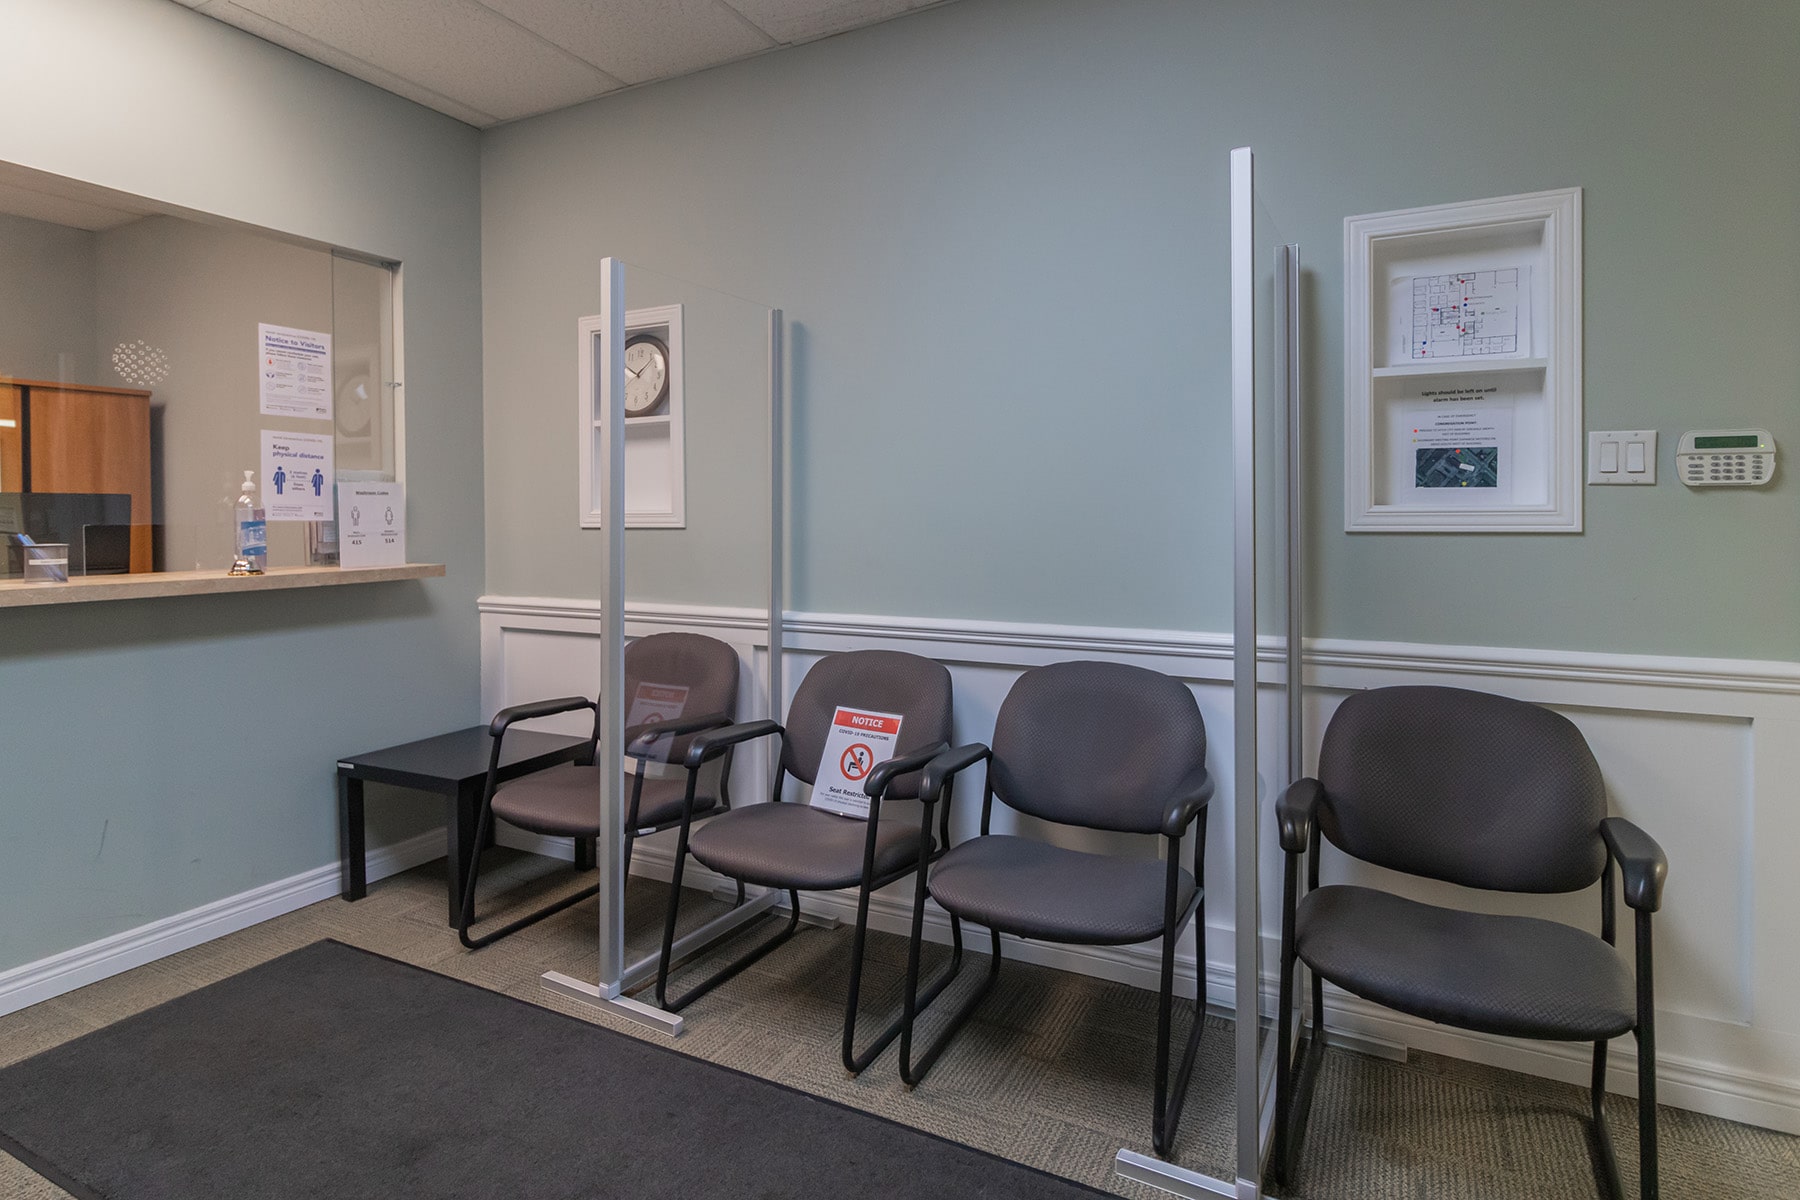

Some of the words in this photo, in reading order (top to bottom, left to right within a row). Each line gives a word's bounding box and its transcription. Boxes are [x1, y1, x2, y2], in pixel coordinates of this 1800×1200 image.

[265, 335, 288, 344] Notice
[300, 340, 324, 350] Visitors
[638, 348, 644, 358] 12
[644, 392, 648, 400] 5
[852, 716, 884, 728] NOTICE
[838, 728, 860, 736] COVID-19
[860, 732, 890, 741] PRECAUTIONS
[828, 786, 842, 794] Seat
